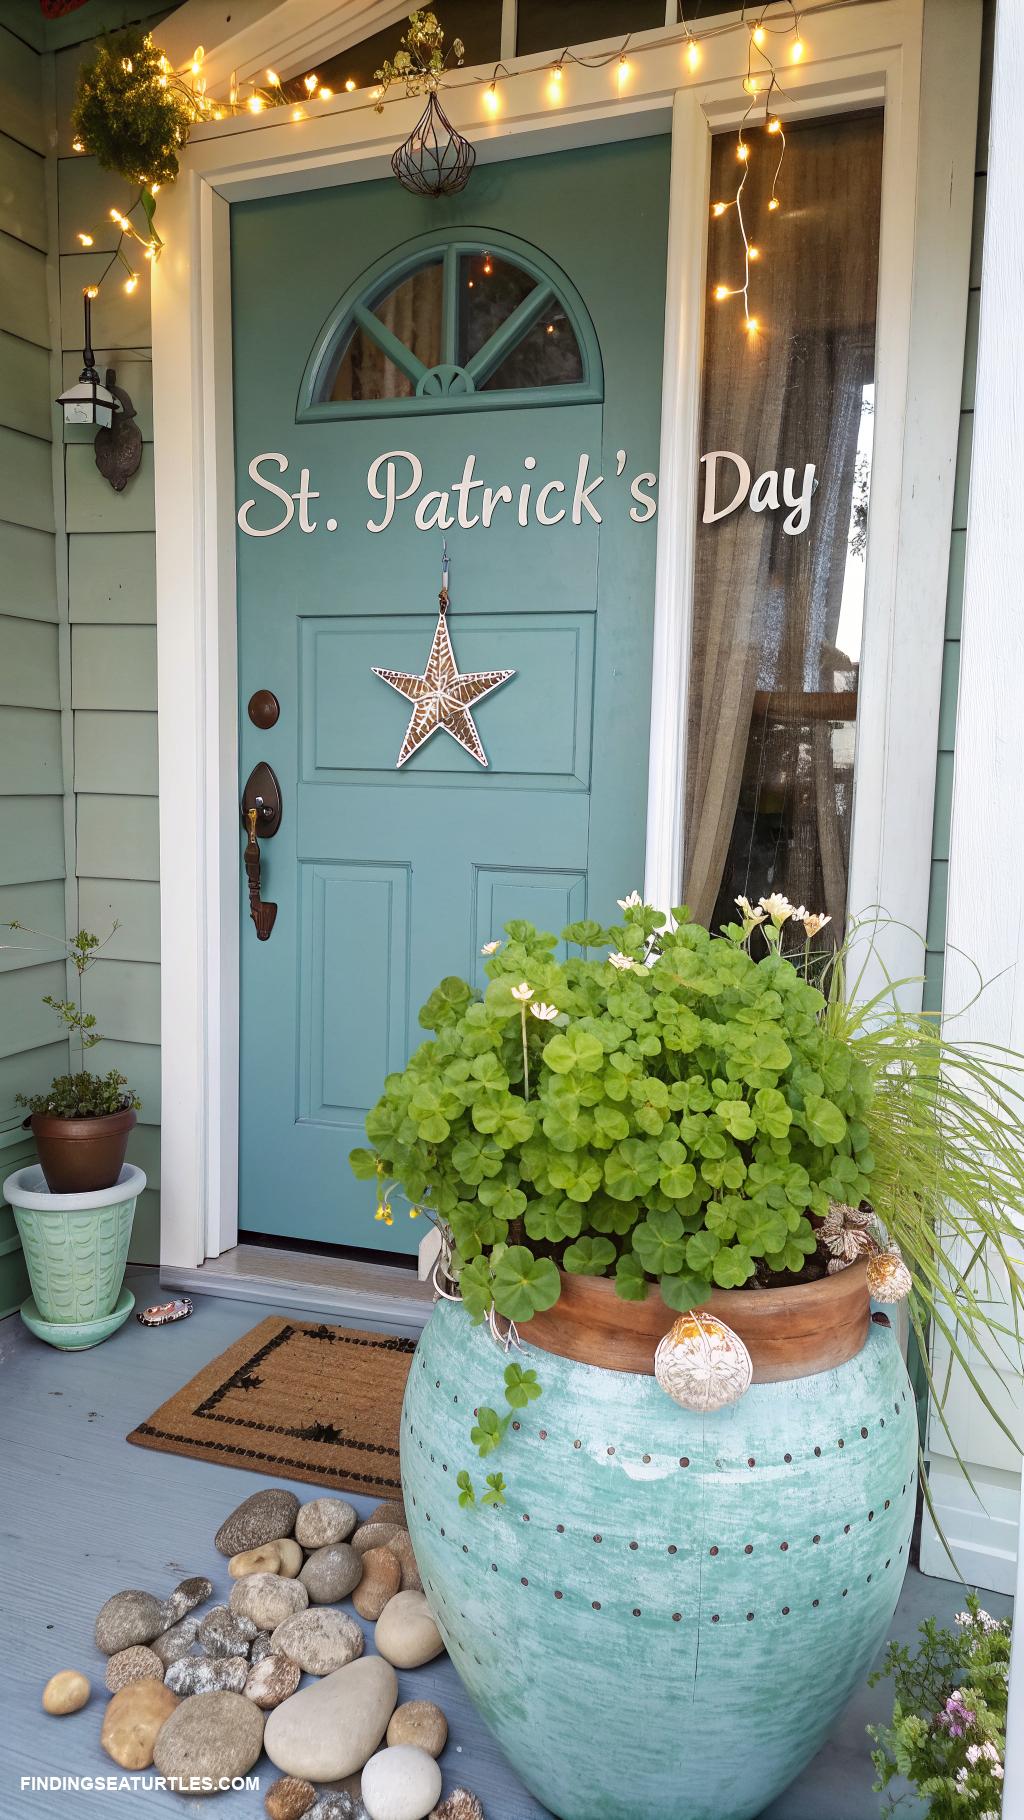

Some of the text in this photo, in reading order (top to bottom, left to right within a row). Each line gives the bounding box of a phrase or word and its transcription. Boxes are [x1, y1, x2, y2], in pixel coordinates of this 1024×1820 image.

[237, 449, 817, 537] St. Patrick's Day
